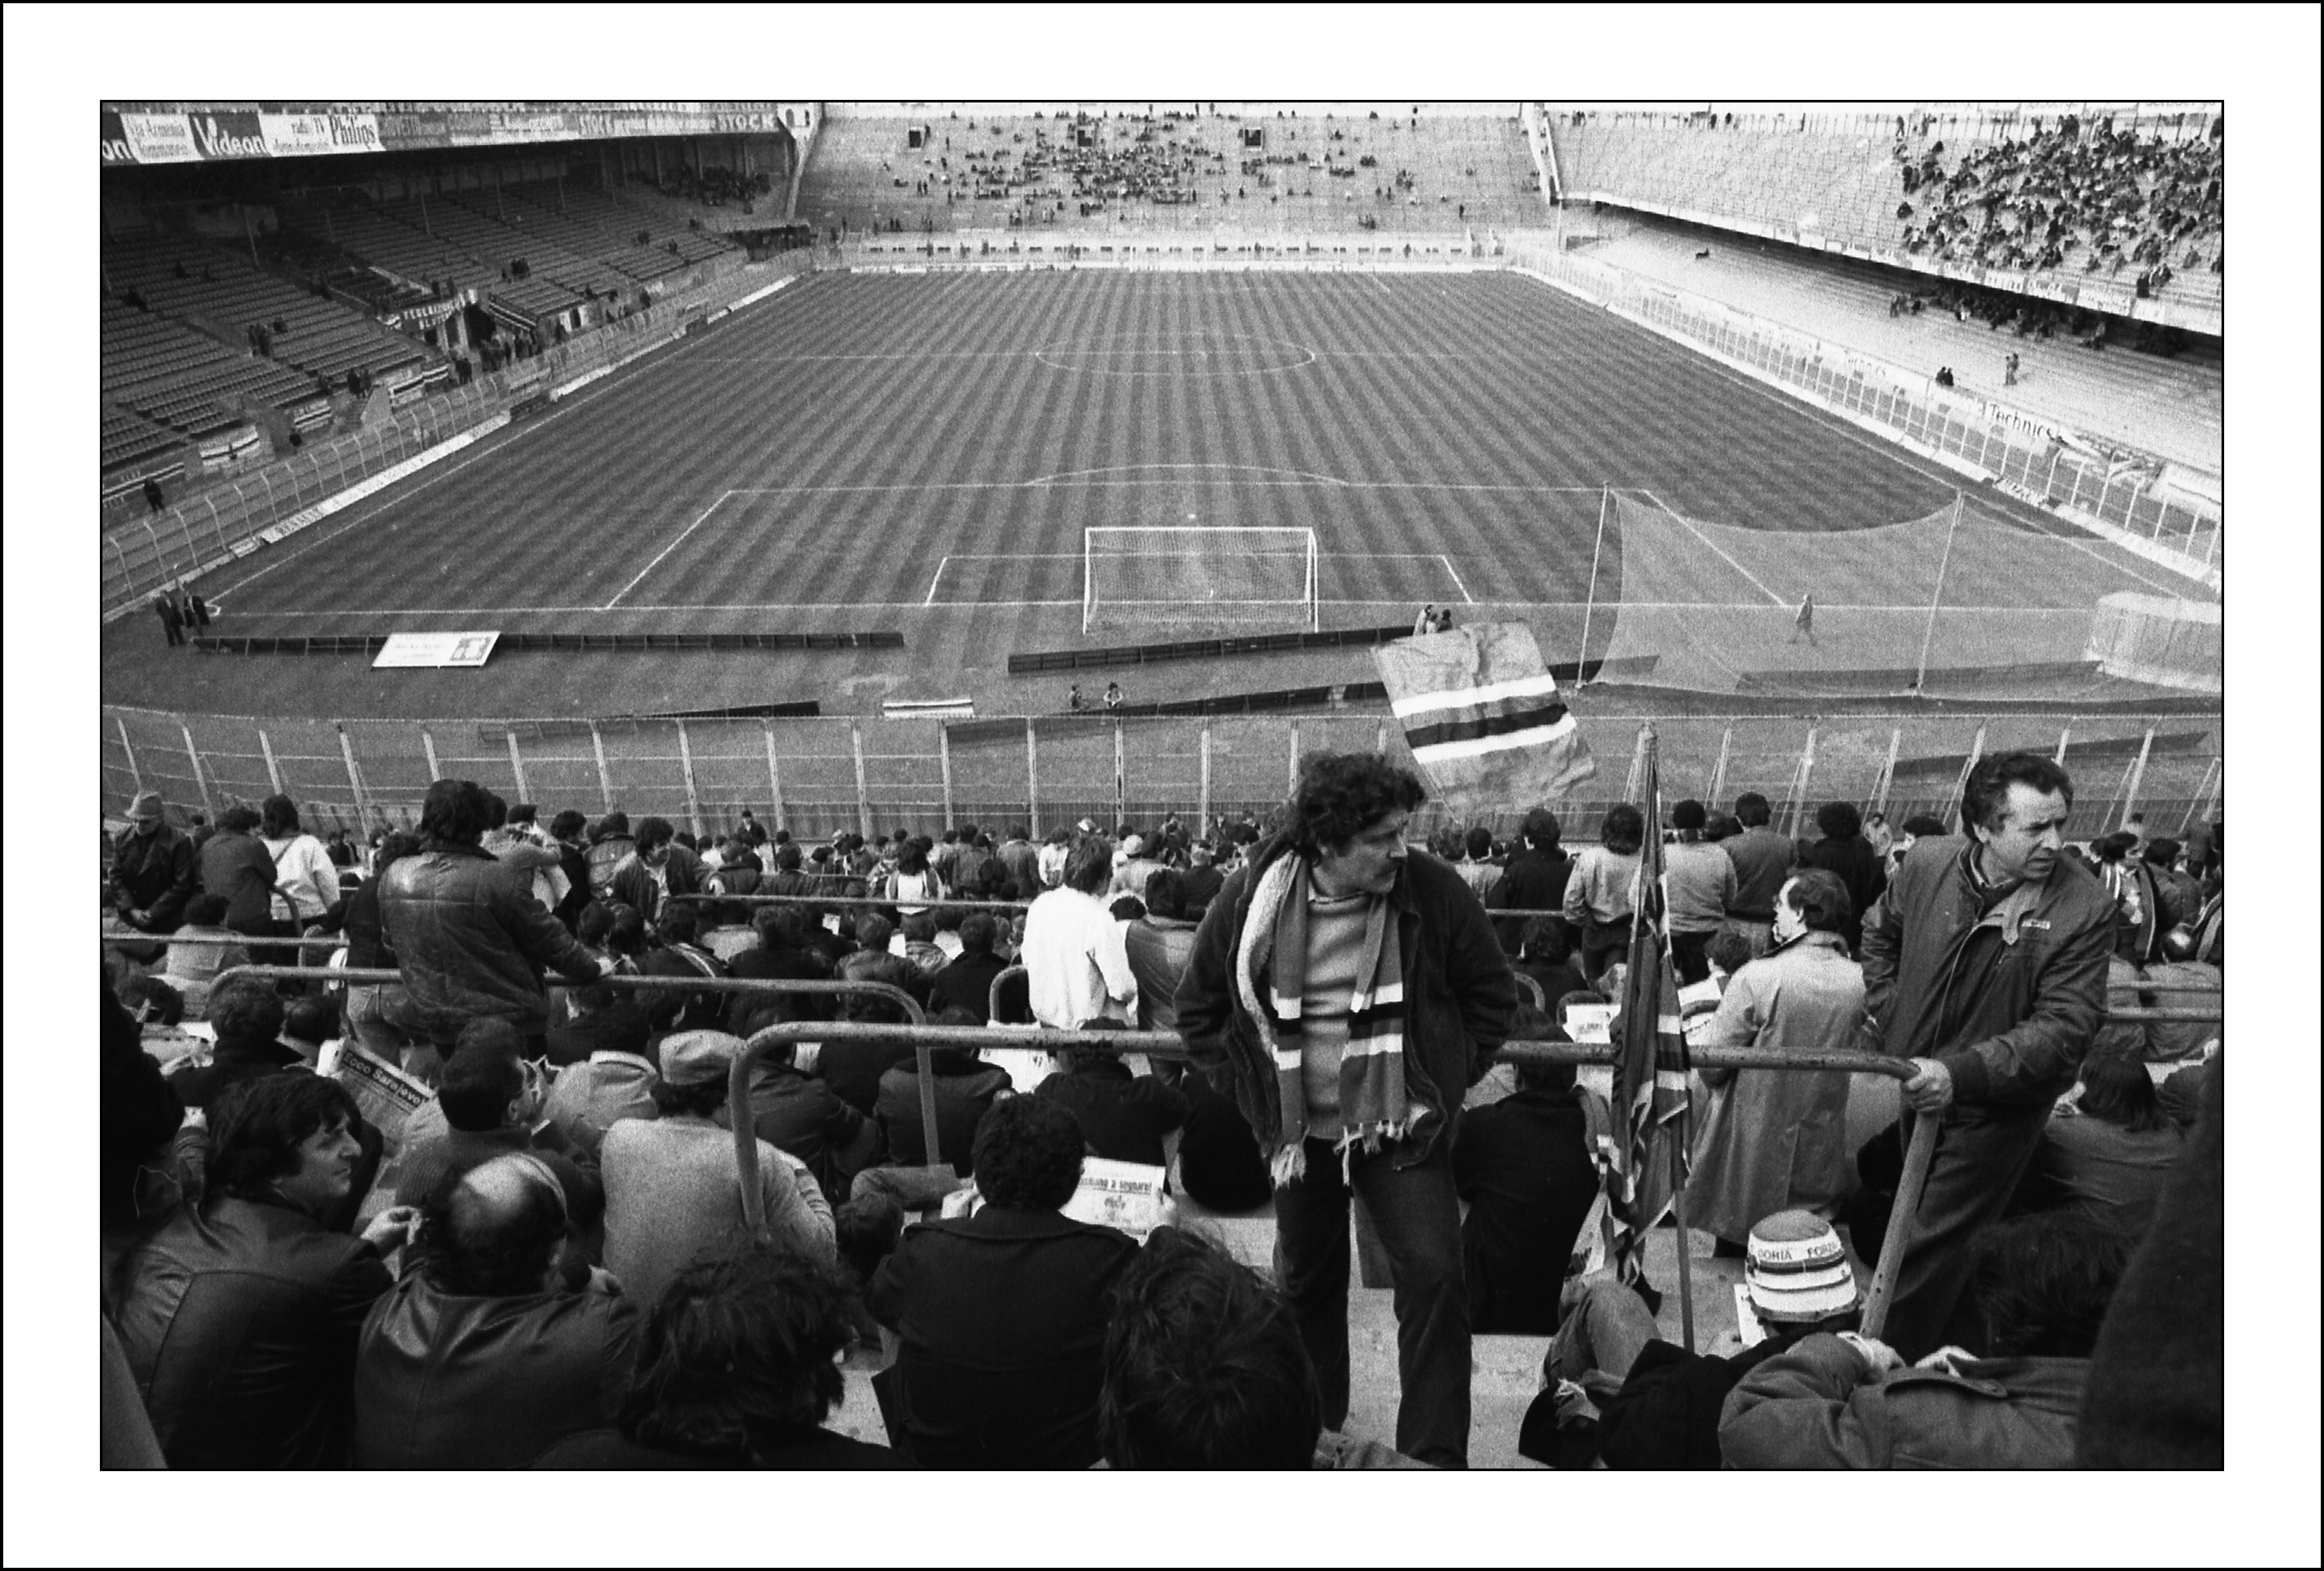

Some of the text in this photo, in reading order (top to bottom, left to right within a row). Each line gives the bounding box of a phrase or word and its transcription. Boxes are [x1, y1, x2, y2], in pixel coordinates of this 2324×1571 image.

[193, 116, 266, 157] Videon
[327, 115, 377, 151] Philips
[578, 114, 612, 135] STOCK
[715, 113, 779, 132] STOCK
[1990, 403, 2054, 440] Technics
